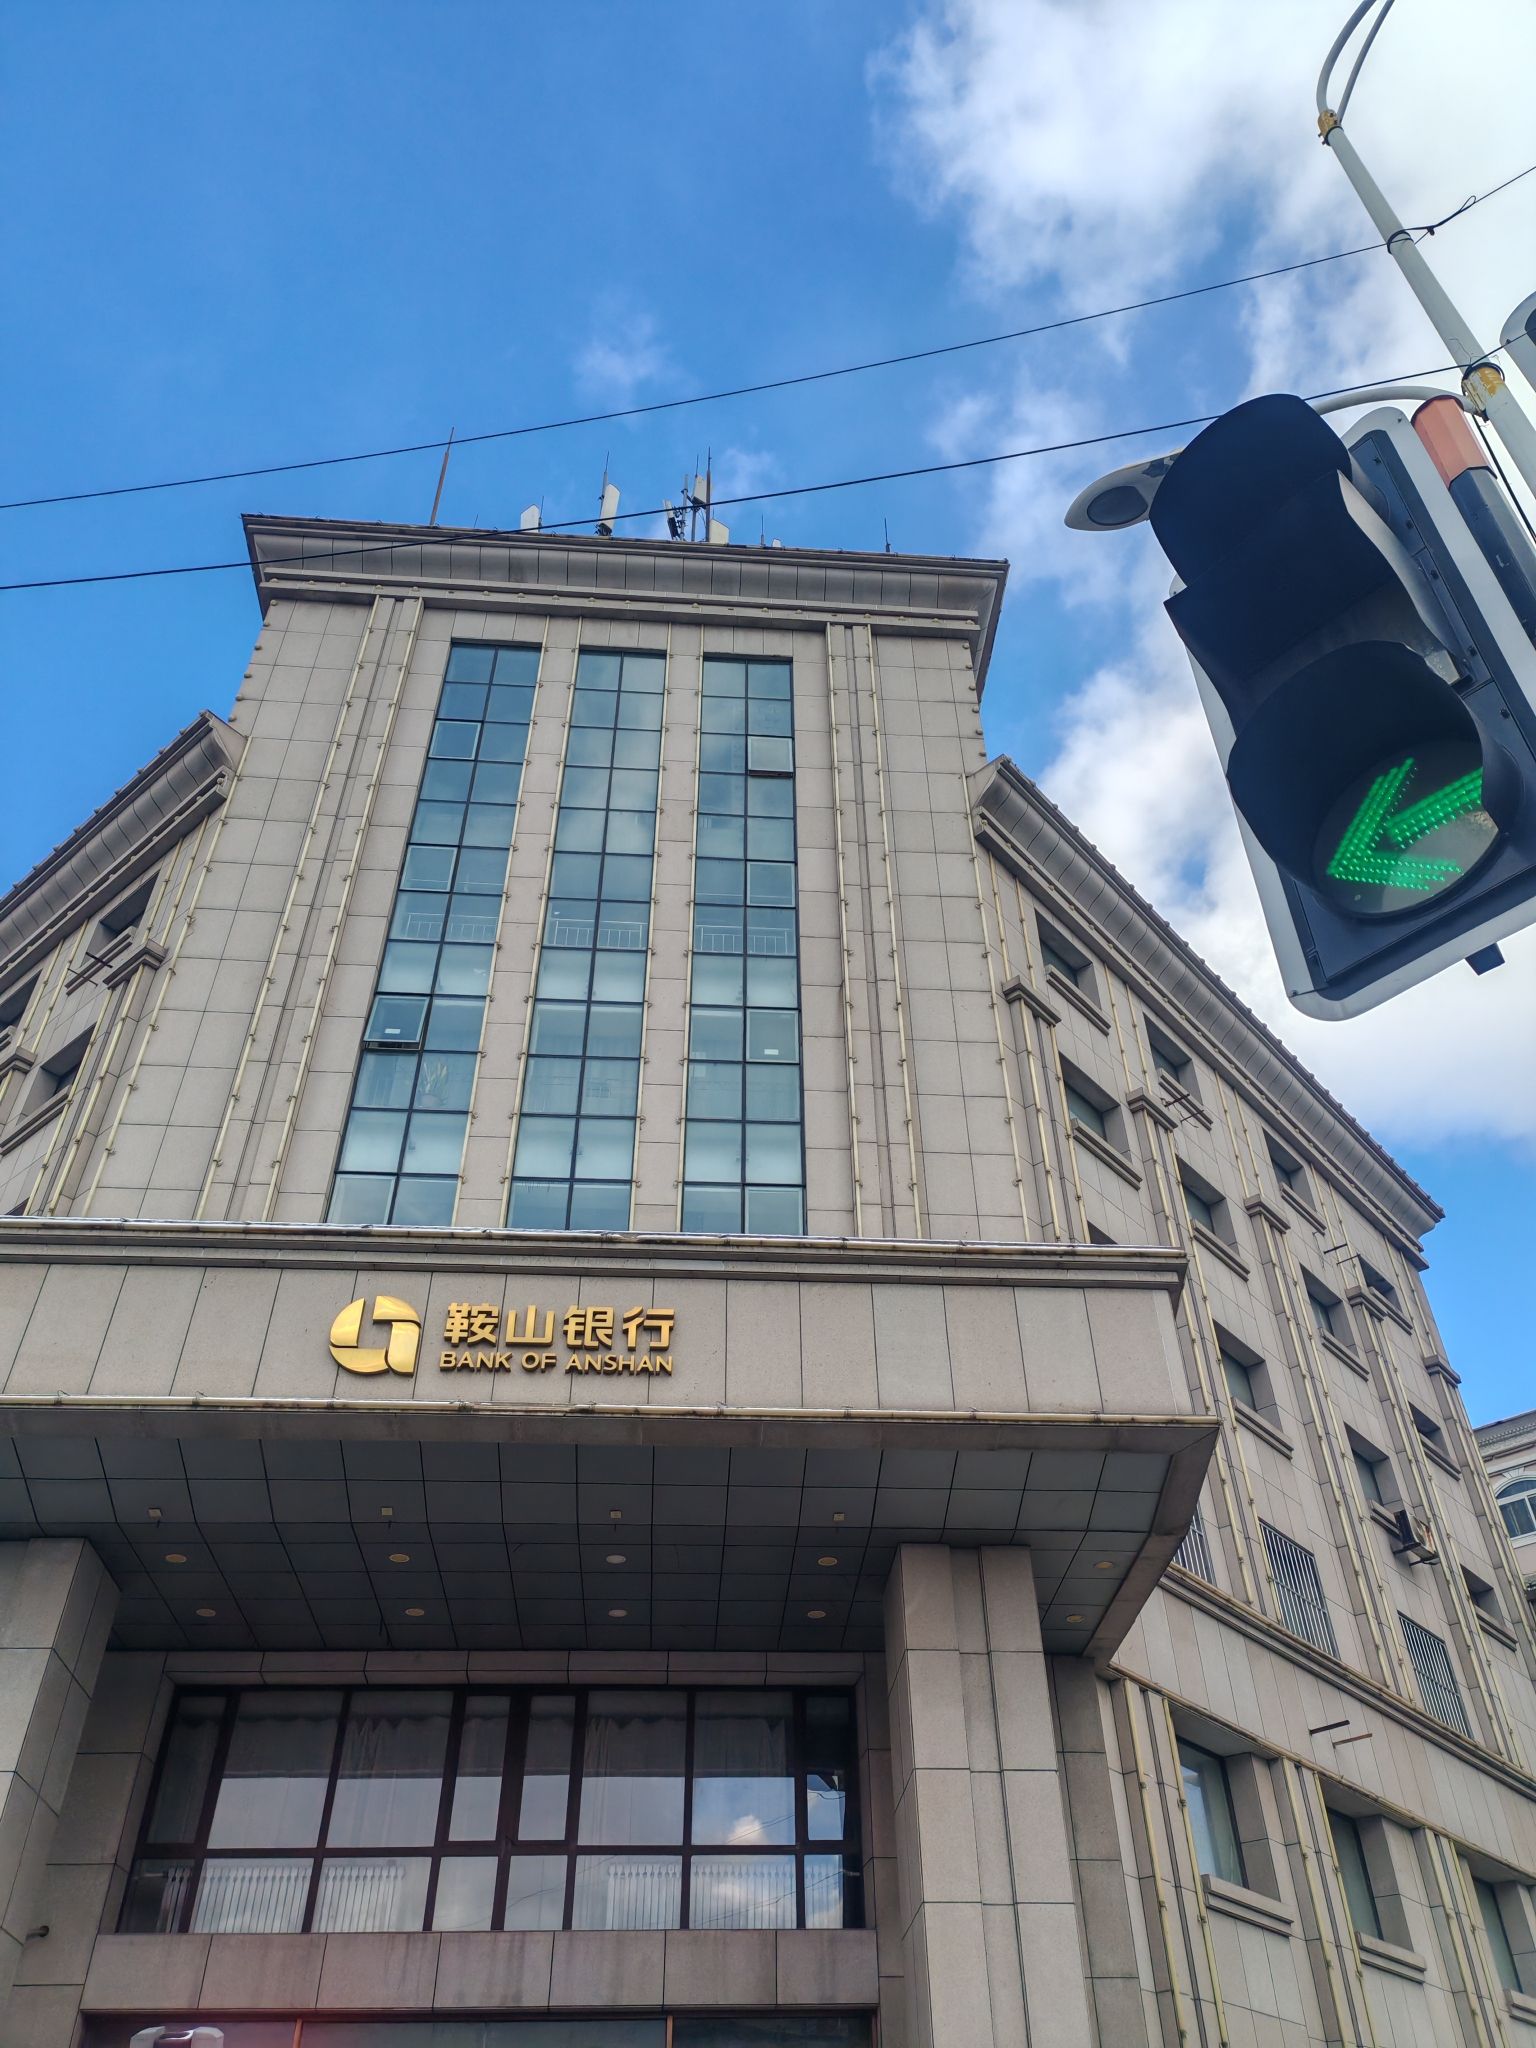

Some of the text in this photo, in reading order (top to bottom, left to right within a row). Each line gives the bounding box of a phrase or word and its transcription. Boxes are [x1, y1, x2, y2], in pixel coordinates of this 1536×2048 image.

[443, 1302, 675, 1351] 鞍山银行
[440, 1351, 674, 1376] BANK OF ANSHAN
